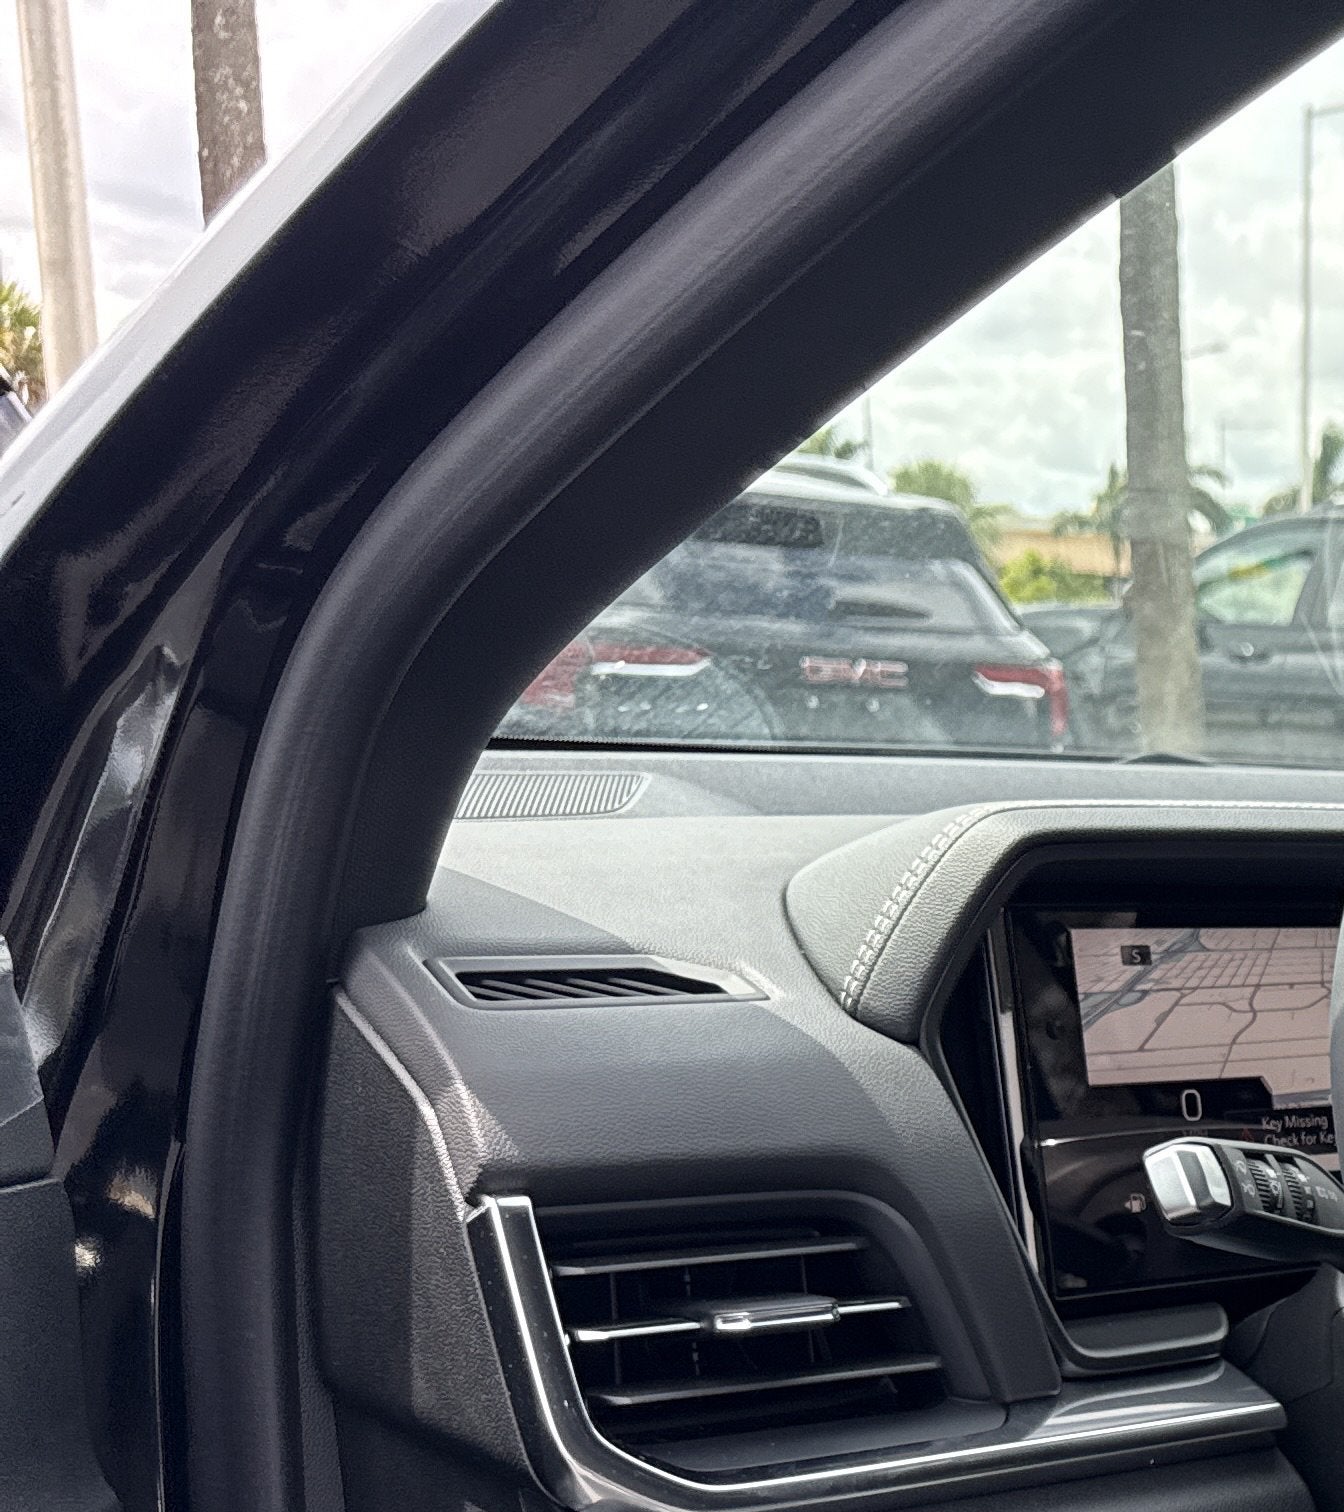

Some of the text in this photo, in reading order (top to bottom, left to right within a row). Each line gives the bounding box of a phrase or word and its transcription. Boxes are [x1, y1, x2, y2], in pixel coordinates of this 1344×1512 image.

[1181, 1088, 1203, 1122] 0
[1261, 1115, 1329, 1132] Key Missing
[1264, 1130, 1337, 1146] Check for Ke
